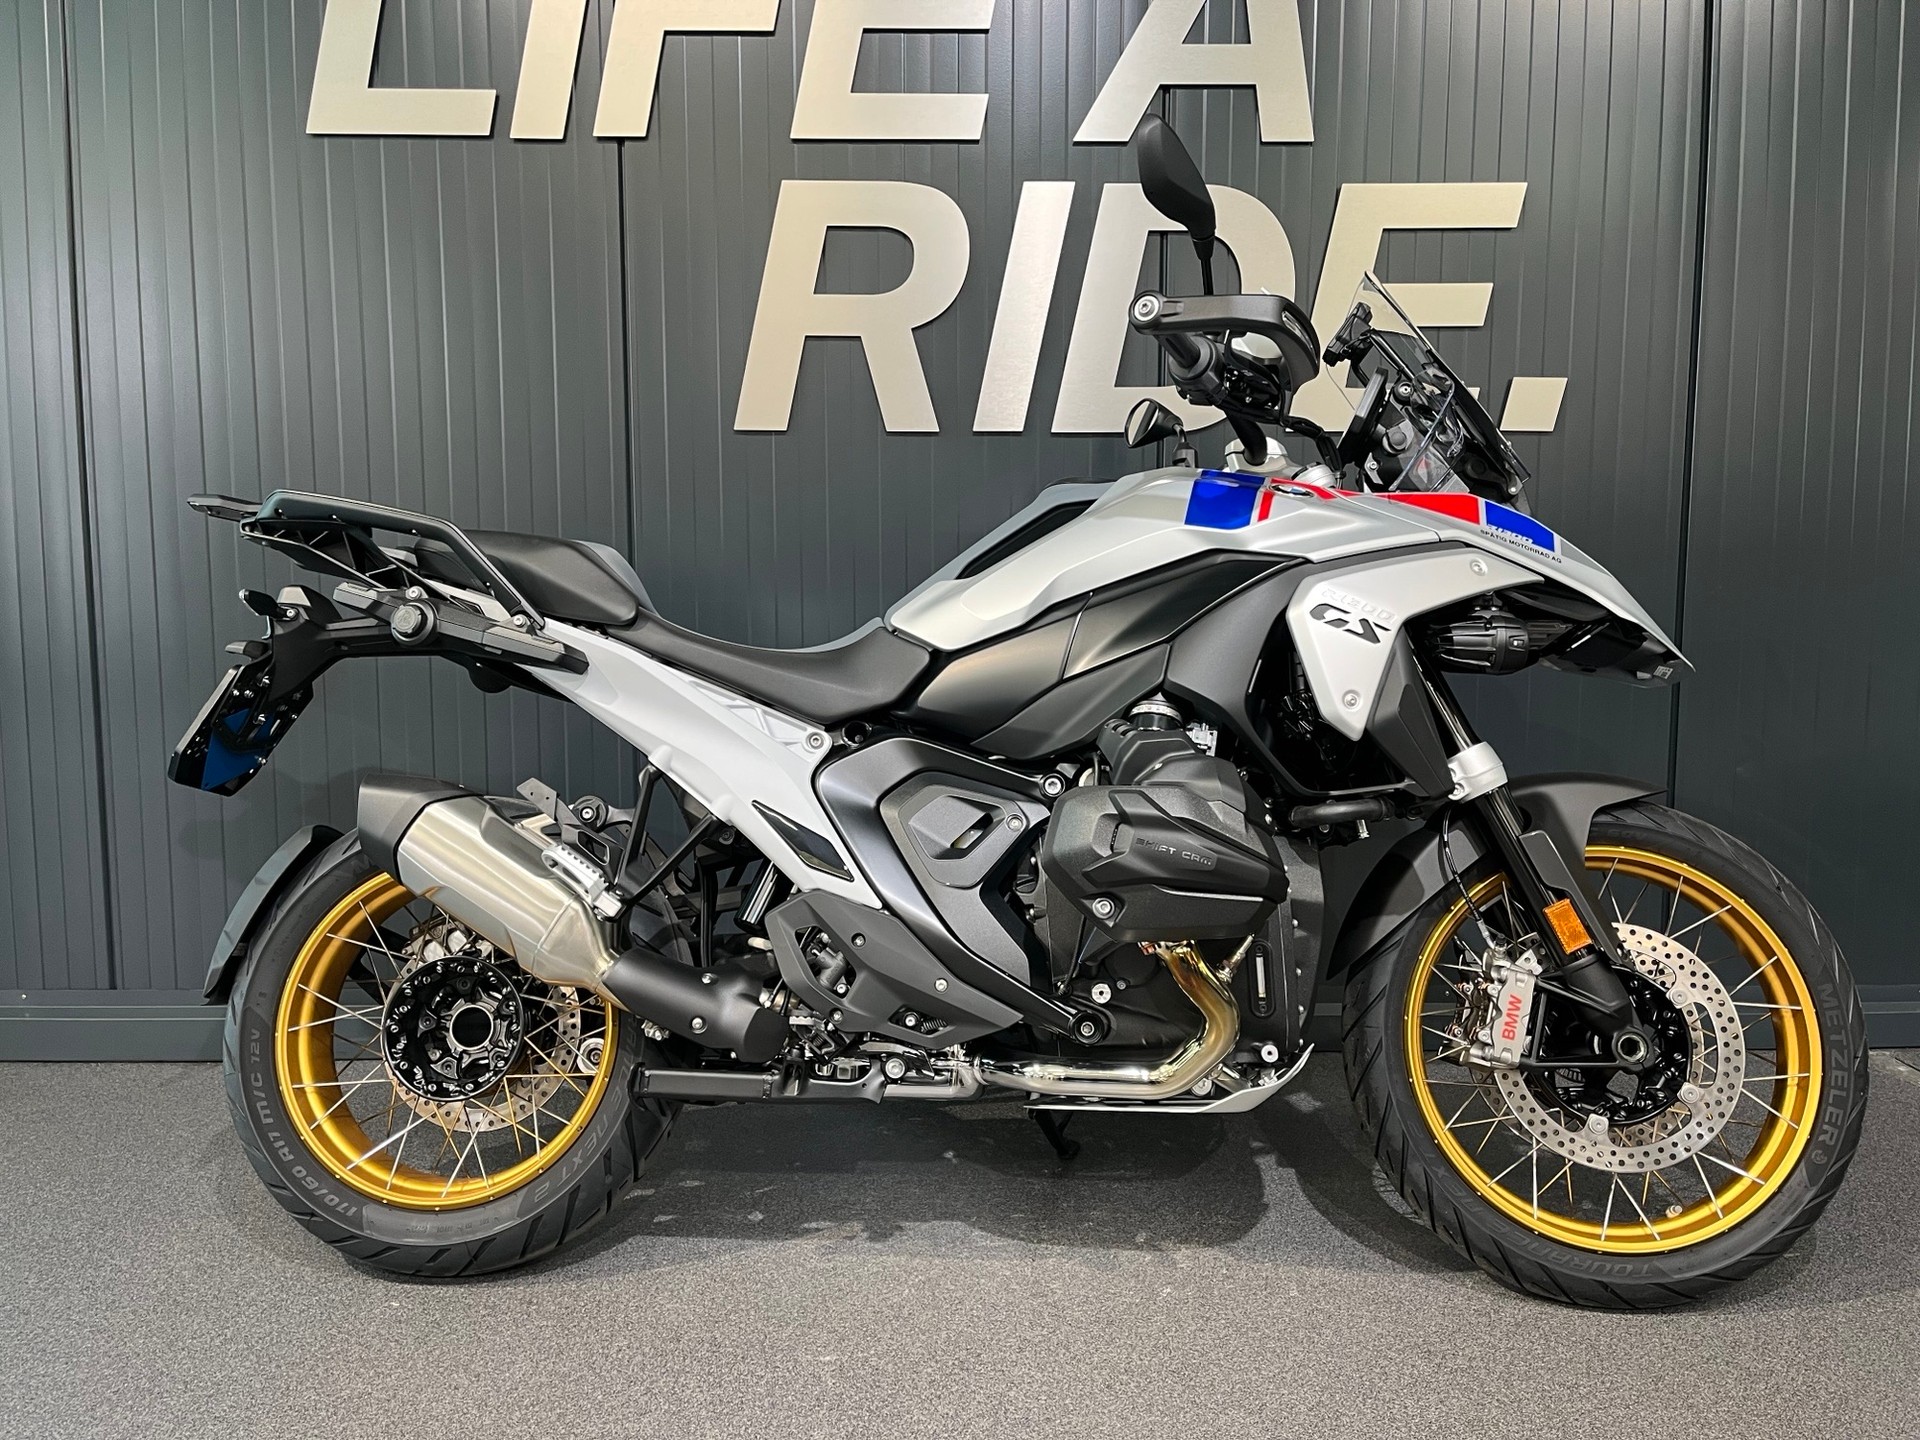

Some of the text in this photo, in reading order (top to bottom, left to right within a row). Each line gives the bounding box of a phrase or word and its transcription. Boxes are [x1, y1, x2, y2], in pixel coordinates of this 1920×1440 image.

[733, 180, 1568, 434] RIDE.
[1509, 538, 1550, 559] MOTORRAD
[1551, 555, 1562, 564] AG
[1309, 603, 1391, 644] GS
[1135, 837, 1177, 855] SHIFT
[1502, 994, 1522, 1041] BMW
[1817, 983, 1848, 1146] METZELER
[251, 1072, 274, 1125] M/C
[268, 1131, 295, 1162] R17
[557, 1114, 609, 1188] NEXT
[291, 1165, 358, 1217] 170/60
[1489, 1219, 1660, 1278] TOURANCE
